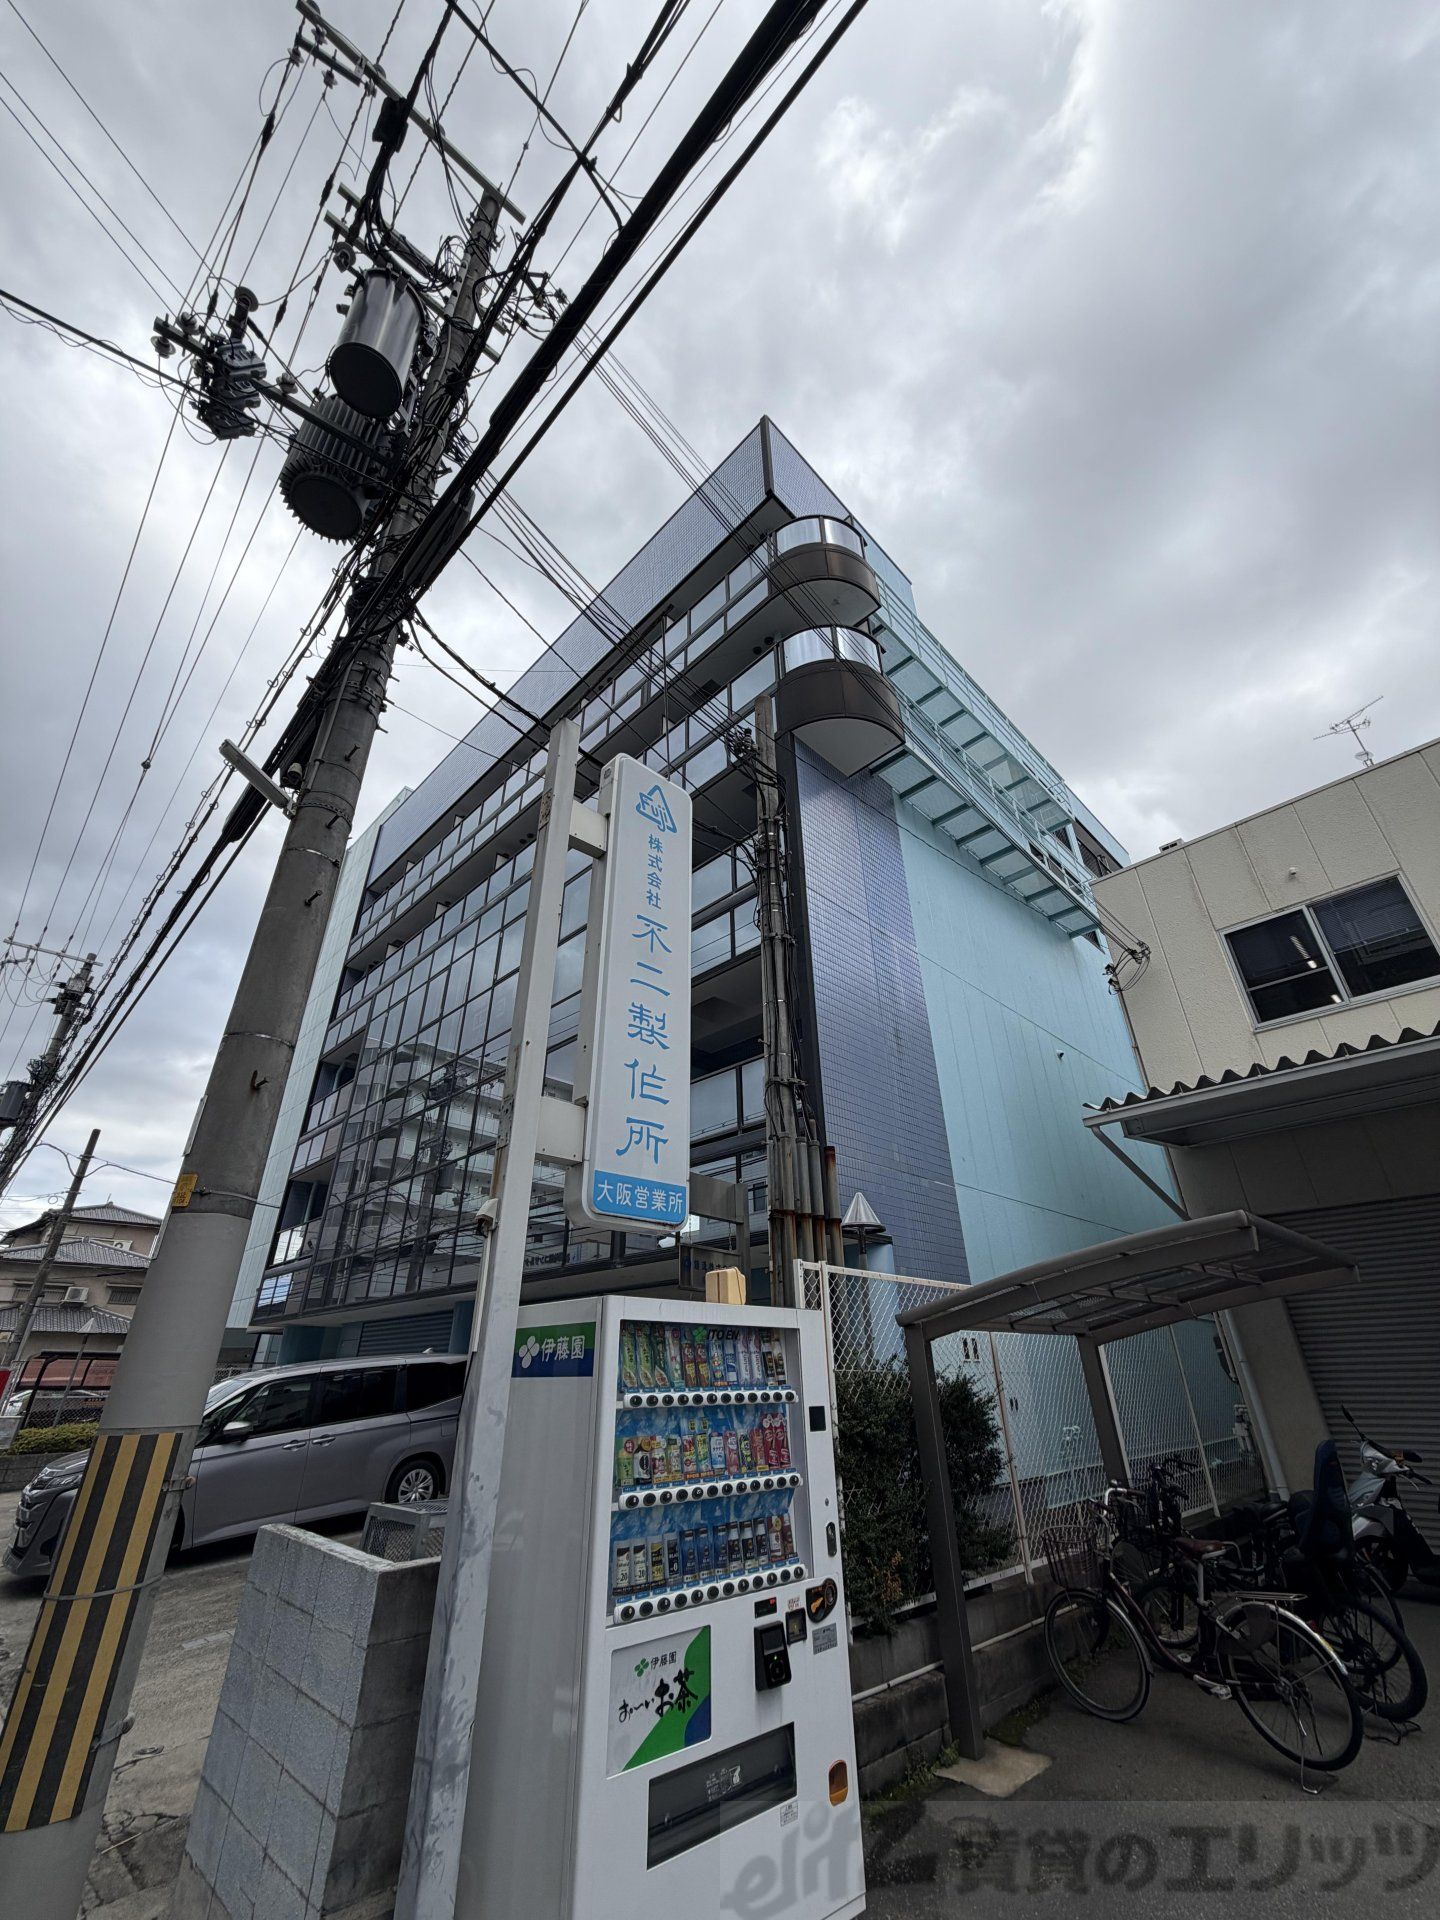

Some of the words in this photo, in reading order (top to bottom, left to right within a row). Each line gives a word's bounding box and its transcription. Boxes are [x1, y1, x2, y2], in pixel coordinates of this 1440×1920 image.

[646, 834, 664, 909] 株式会社
[616, 914, 671, 1165] 不二製作所
[597, 1179, 683, 1214] 大阪営業所
[541, 1335, 586, 1362] 伊藤園
[650, 1651, 677, 1670] 伊藤園
